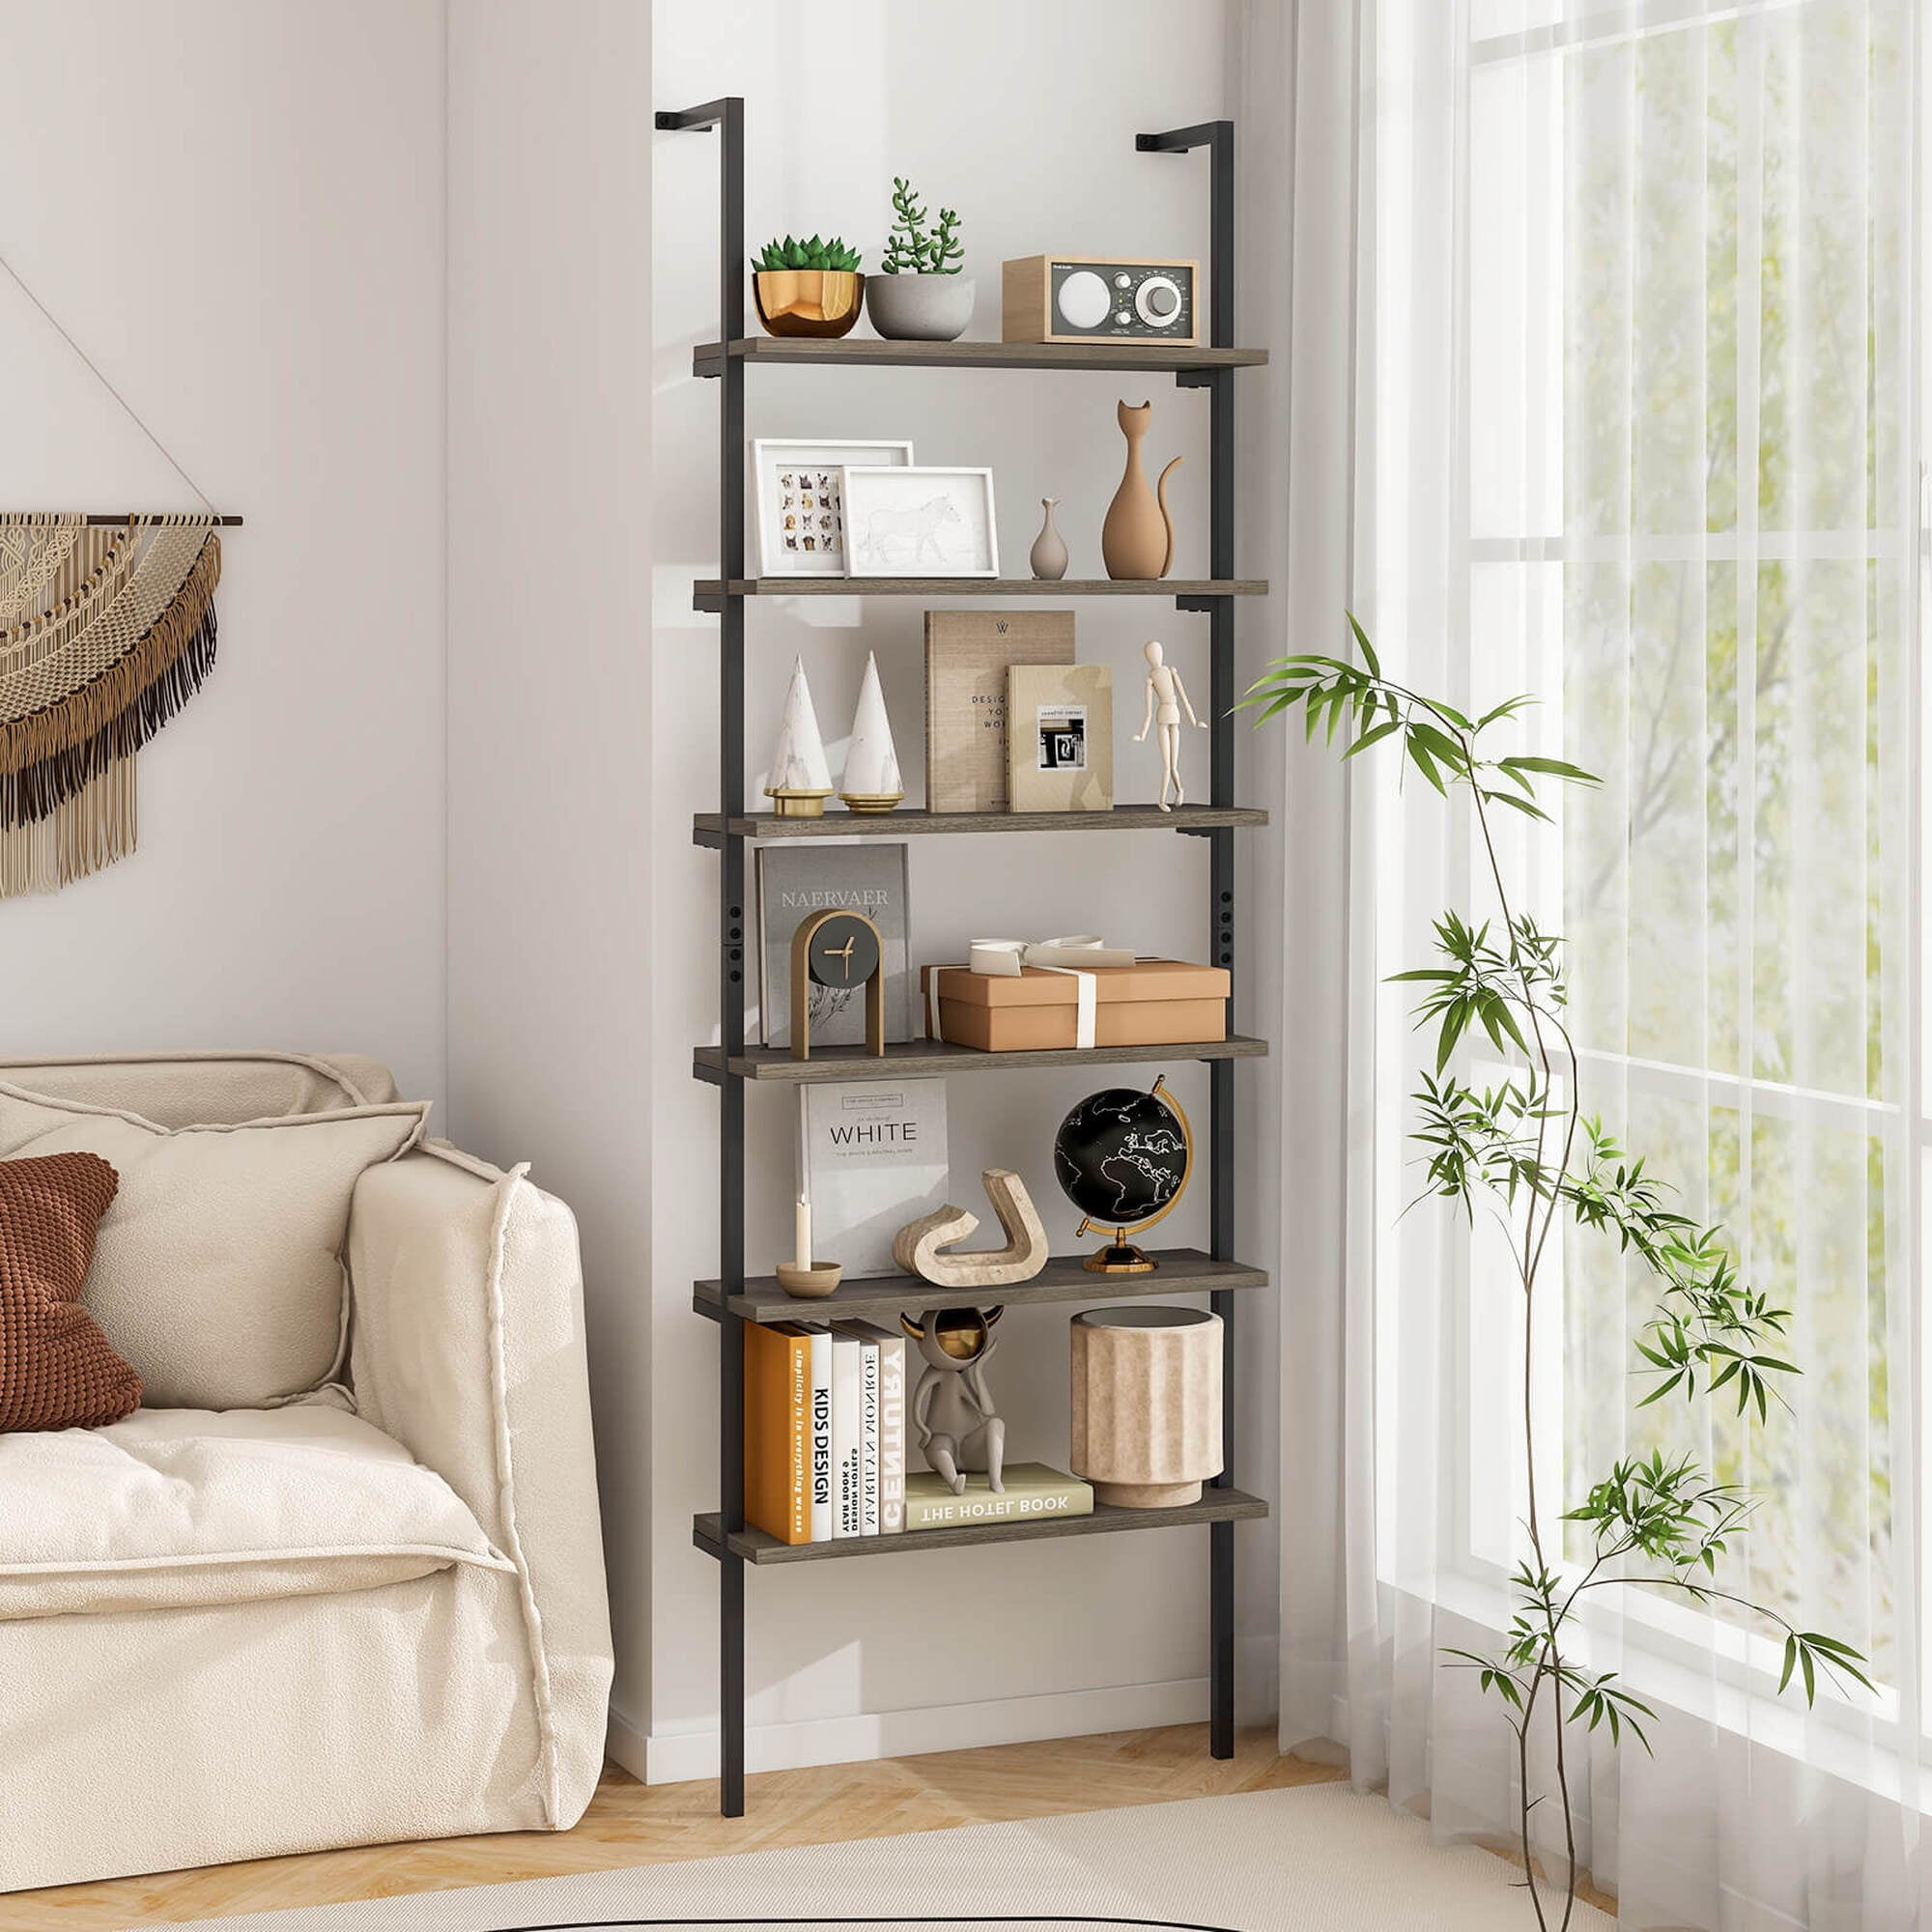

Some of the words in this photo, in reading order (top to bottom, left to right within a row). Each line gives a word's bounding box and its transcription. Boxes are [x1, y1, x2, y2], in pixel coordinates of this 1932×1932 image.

[781, 889, 889, 907] NAERVAER
[830, 1122, 917, 1145] WHITE
[794, 1349, 804, 1405] simplicity
[814, 1388, 829, 1432] KIDS
[794, 1435, 804, 1493] everything
[814, 1435, 829, 1504] DESIGN
